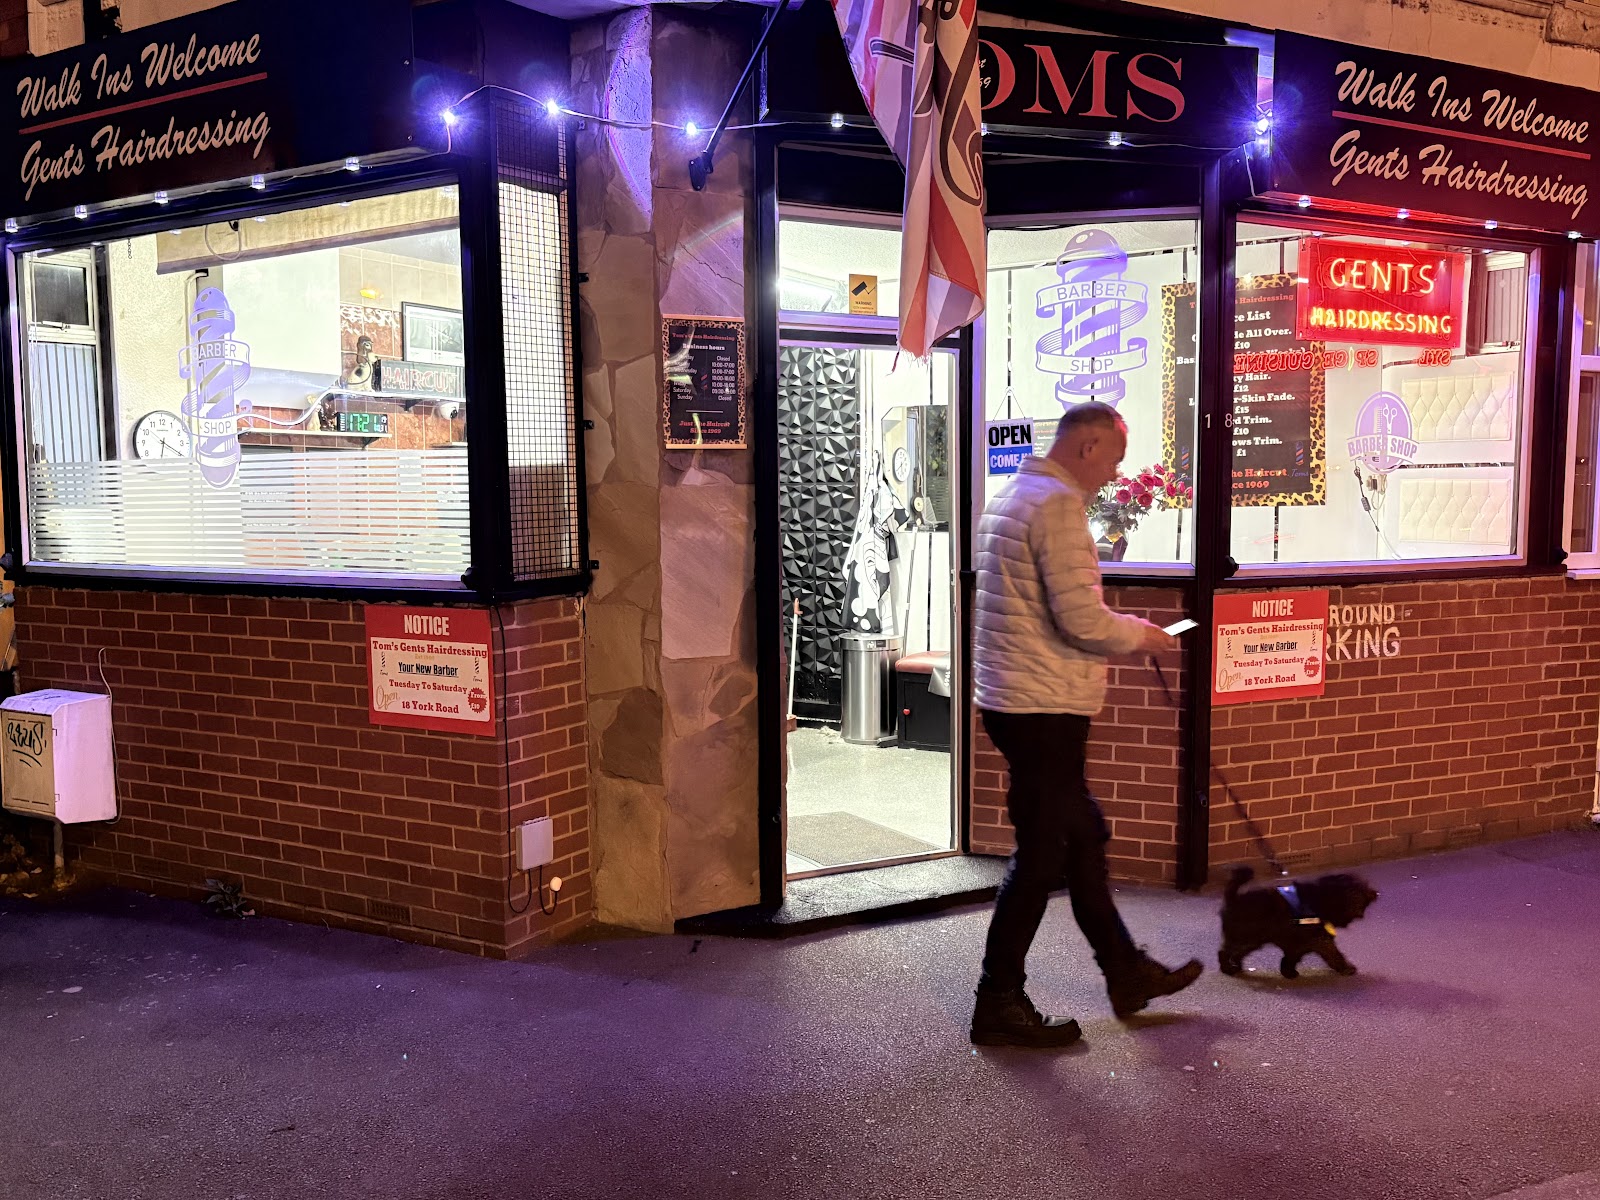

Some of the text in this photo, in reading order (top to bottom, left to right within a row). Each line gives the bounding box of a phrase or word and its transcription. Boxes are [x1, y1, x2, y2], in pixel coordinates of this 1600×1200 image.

[17, 33, 261, 118] Walk Ins Welcome
[1335, 60, 1589, 143] Walk Ins Welcome
[20, 109, 271, 201] Gents Hairdressing
[1329, 129, 1588, 219] Gents Hairdressing
[1329, 257, 1435, 294] GENTS
[1056, 283, 1128, 300] BARBER
[1239, 293, 1295, 304] Hairdressing
[1246, 310, 1271, 321] List
[1310, 306, 1452, 334] HAIRDRESSING
[1245, 329, 1263, 338] All
[1263, 328, 1292, 337] Over.
[191, 343, 237, 360] BARBER
[1234, 341, 1251, 350] £10
[1070, 358, 1114, 373] SHOP
[1176, 356, 1195, 365] Bas
[1245, 373, 1272, 381] Hair.
[1233, 384, 1250, 393] £12
[1266, 392, 1296, 401] Fade.
[1234, 405, 1250, 414] £15
[159, 418, 166, 426] 12
[1243, 415, 1273, 424] Trim.
[203, 420, 232, 434] SHOP
[1233, 427, 1250, 436] £10
[988, 424, 1032, 446] OPEN
[1253, 436, 1283, 446] Trim.
[1236, 448, 1247, 457] £1
[1390, 437, 1418, 459] SHOP
[989, 453, 1020, 469] COME
[1245, 468, 1288, 478] Haircut
[1245, 480, 1270, 489] 1969
[1252, 598, 1295, 618] NOTICE
[403, 614, 450, 636] NOTICE
[1219, 621, 1324, 636] Tom's Gents Hairdressing
[372, 640, 488, 659] Tom's Gents Hairdressing
[1243, 640, 1298, 653] Your New Barber
[398, 661, 459, 676] Your New Barber
[1233, 656, 1305, 669] Tuesday To Saturday
[388, 679, 468, 695] Tuesday To Saturday
[1244, 674, 1296, 686] 18 York Road
[401, 700, 460, 714] 18 York Road
